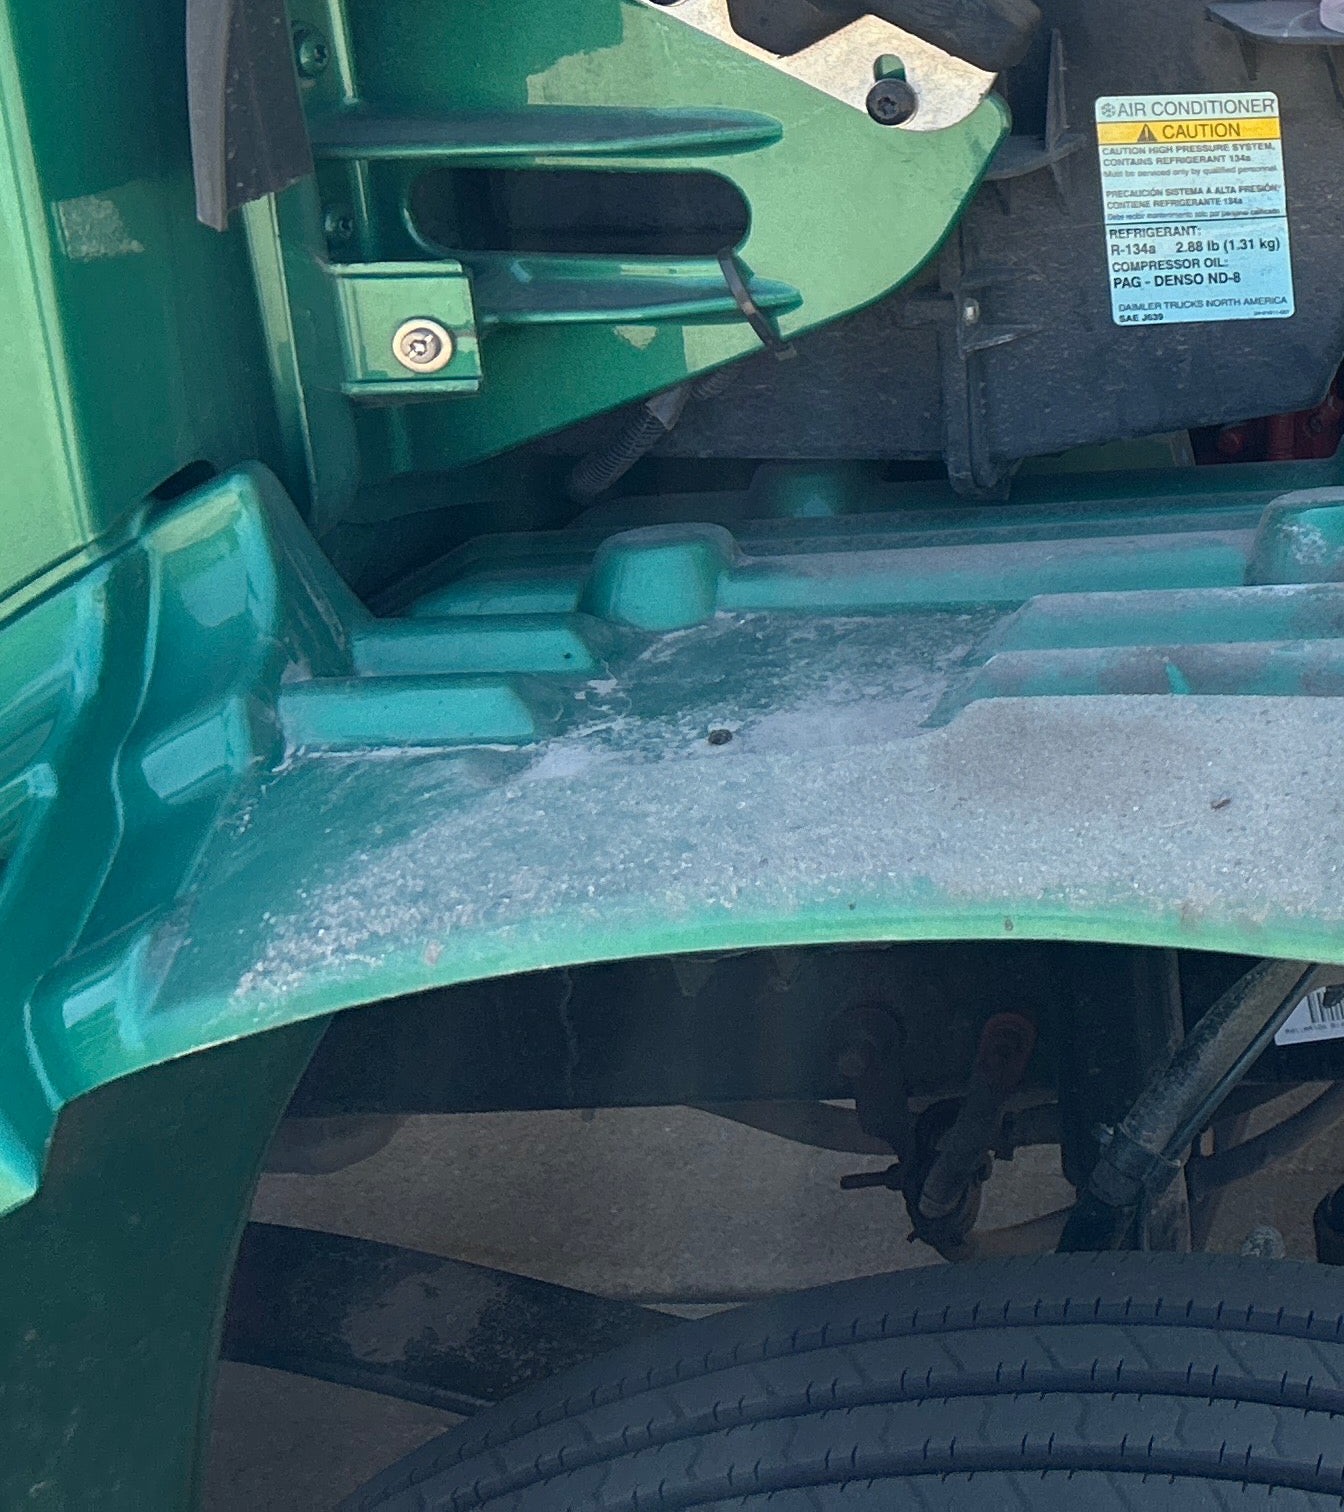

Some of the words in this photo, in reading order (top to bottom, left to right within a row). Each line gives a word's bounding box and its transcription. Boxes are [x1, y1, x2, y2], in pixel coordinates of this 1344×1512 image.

[1118, 102, 1146, 117] AIR
[1152, 99, 1275, 116] CONDITIONER
[1162, 123, 1241, 139] CAUTION
[1103, 146, 1145, 155] CAUTION
[1149, 145, 1173, 154] HIGH
[1176, 143, 1229, 153] PRESSURE
[1104, 157, 1153, 166] CONTAINS
[1156, 155, 1226, 164] REFRIGERANT
[1166, 187, 1203, 196] SISTEMA
[1206, 186, 1212, 194] A
[1215, 185, 1236, 194] ALTA
[1107, 200, 1150, 210] CONTIENE
[1153, 198, 1221, 208] REFRIGERANTE
[1110, 226, 1200, 238] REFRIGERANT:
[1111, 243, 1156, 255] R-134a
[1176, 241, 1203, 253] 2.88
[1208, 241, 1219, 251] lb
[1224, 238, 1254, 253] (1.31
[1260, 236, 1280, 251] kg)
[1113, 258, 1199, 272] COMPRESSOR
[1114, 276, 1141, 289] PAG
[1155, 273, 1204, 287] DENSO
[1208, 272, 1240, 284] ND-8
[1119, 301, 1162, 311] DAIMLER
[1165, 300, 1203, 309] TRUCKS
[1206, 298, 1240, 307] NORTH
[1244, 296, 1287, 305] AMERICA
[1119, 314, 1139, 323] SAE
